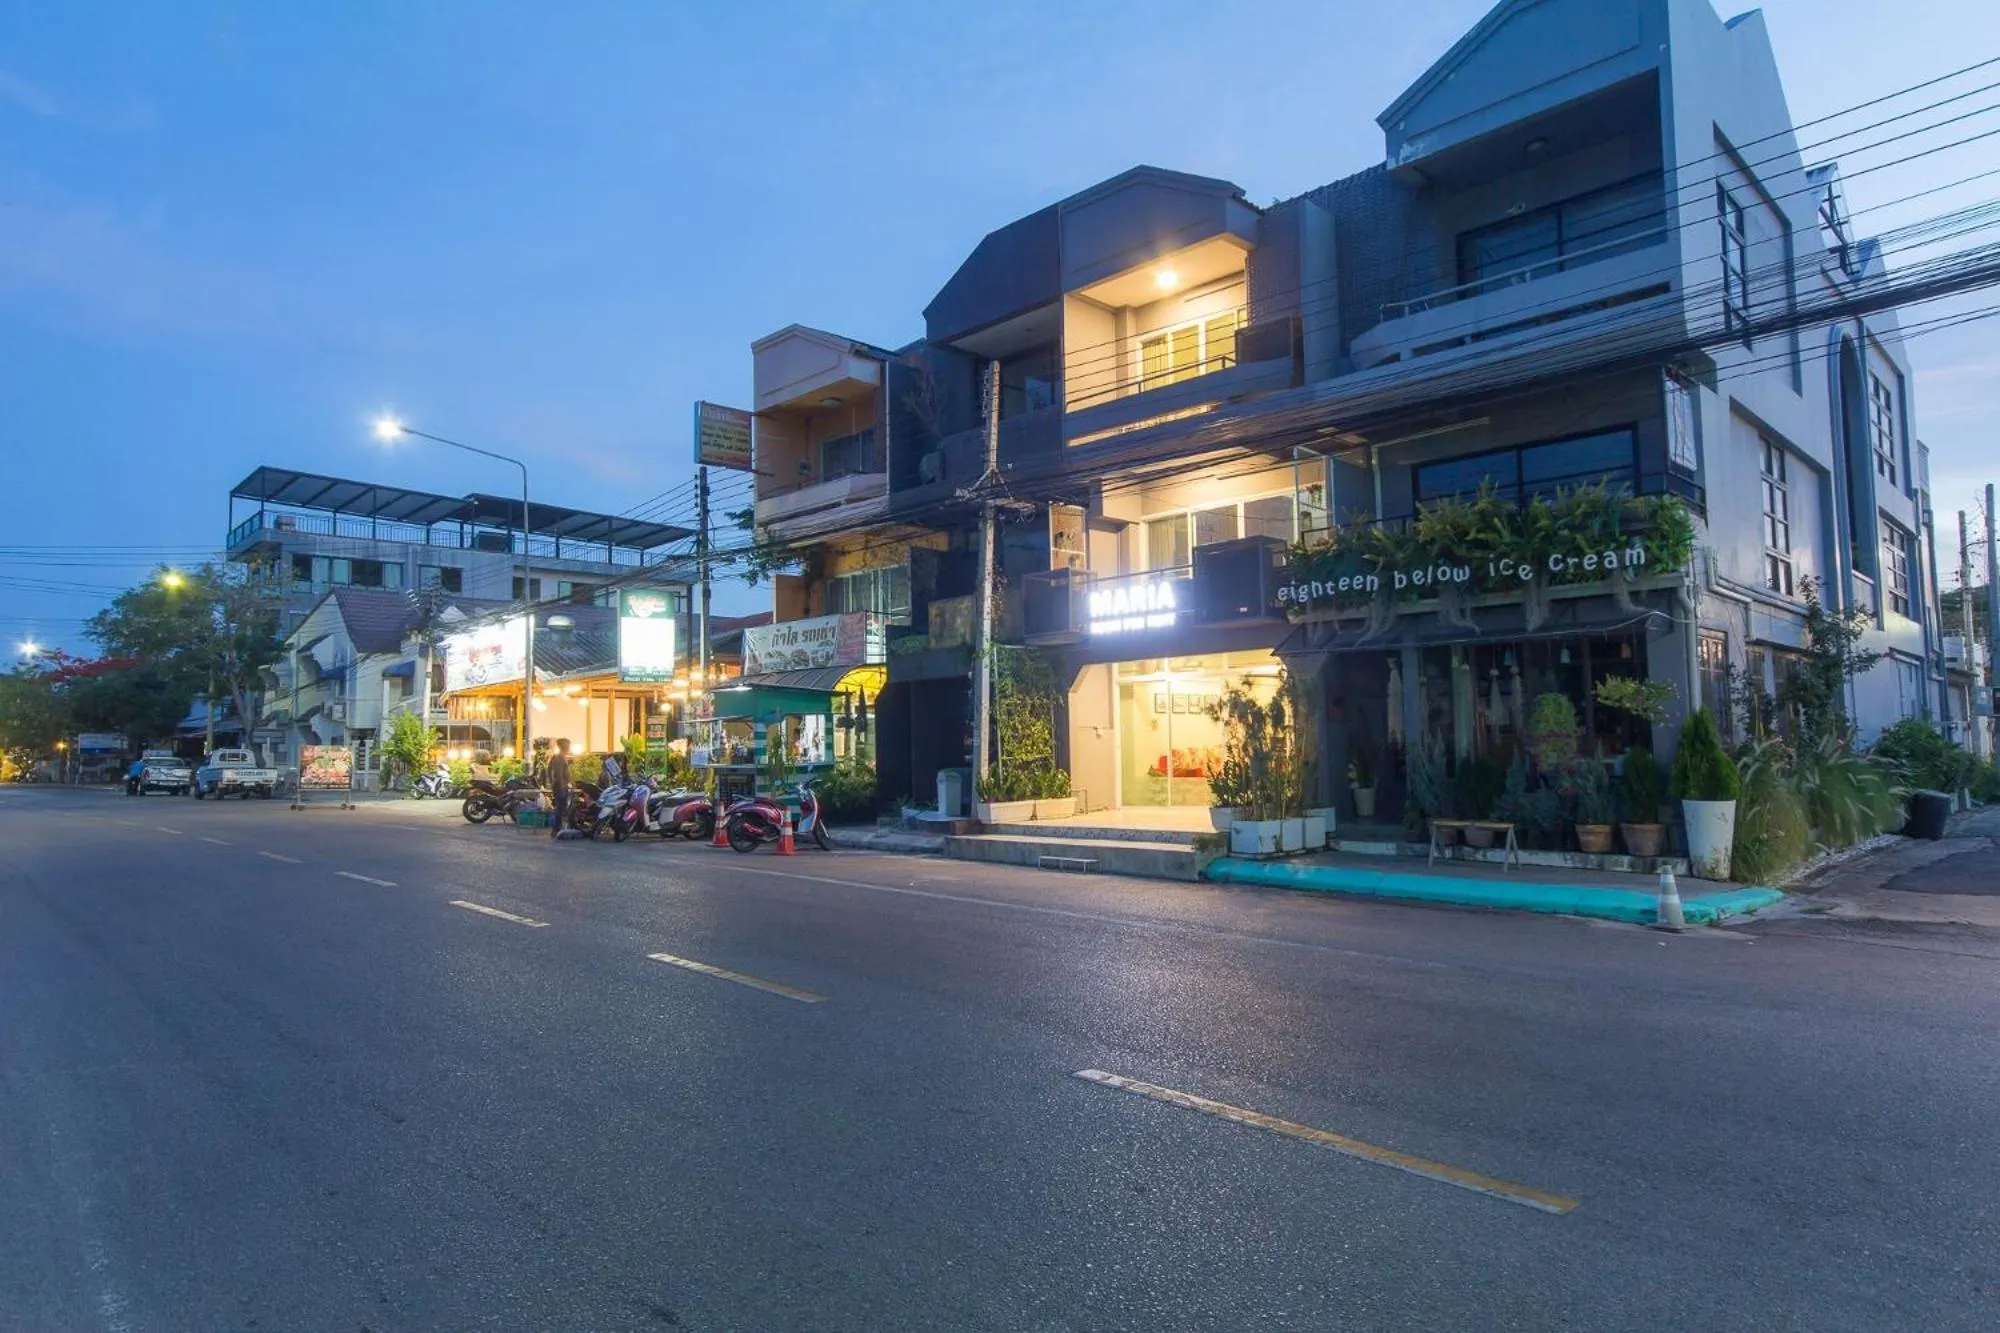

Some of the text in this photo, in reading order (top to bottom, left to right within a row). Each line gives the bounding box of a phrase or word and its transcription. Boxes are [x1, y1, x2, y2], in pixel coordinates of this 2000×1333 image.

[1277, 547, 1646, 603] eighteen below ice cream
[1089, 581, 1175, 618] MARIA
